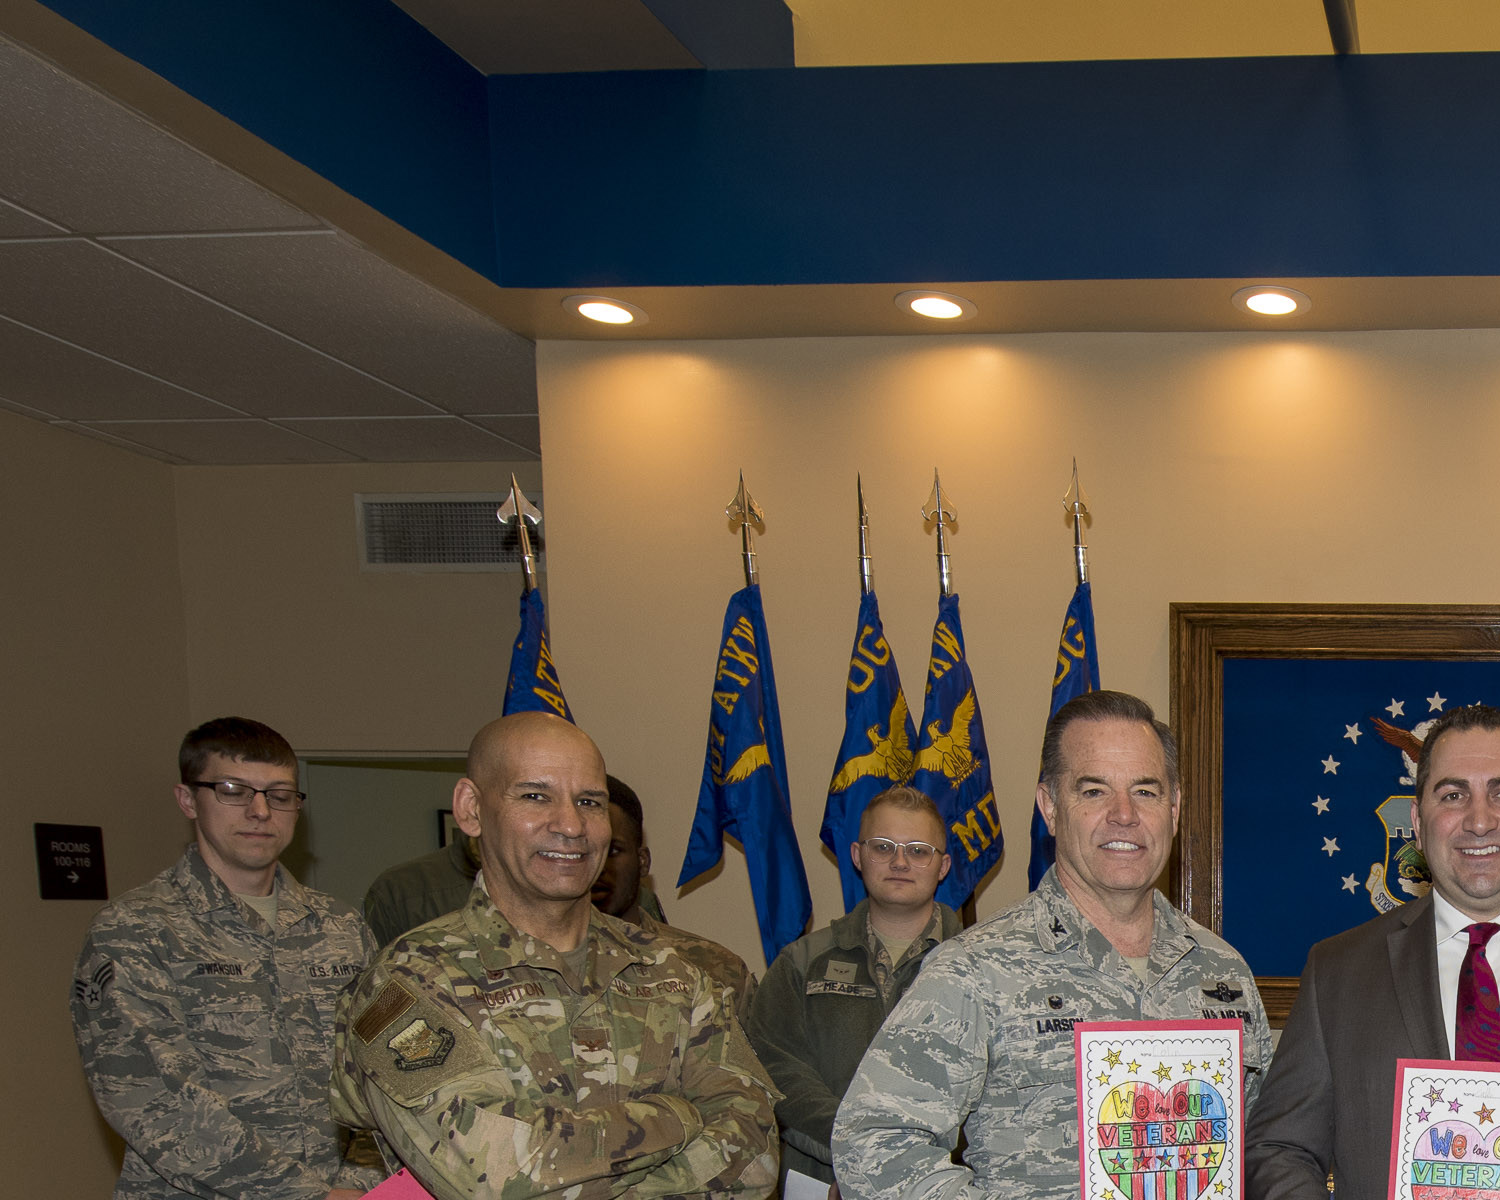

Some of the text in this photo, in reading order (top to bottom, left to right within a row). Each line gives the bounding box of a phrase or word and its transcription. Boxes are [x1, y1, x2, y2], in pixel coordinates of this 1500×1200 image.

[847, 624, 890, 693] OG
[51, 841, 91, 853] ROOMS
[54, 856, 91, 868] 100-116
[197, 963, 243, 976] SWANSON
[309, 967, 330, 977] U.S.
[333, 964, 350, 976] AIR
[823, 982, 860, 995] MEADE
[1112, 1091, 1150, 1119] We
[1155, 1103, 1170, 1116] love
[1098, 1121, 1227, 1147] VETERANS
[1430, 1127, 1467, 1159] We
[1472, 1144, 1490, 1159] love
